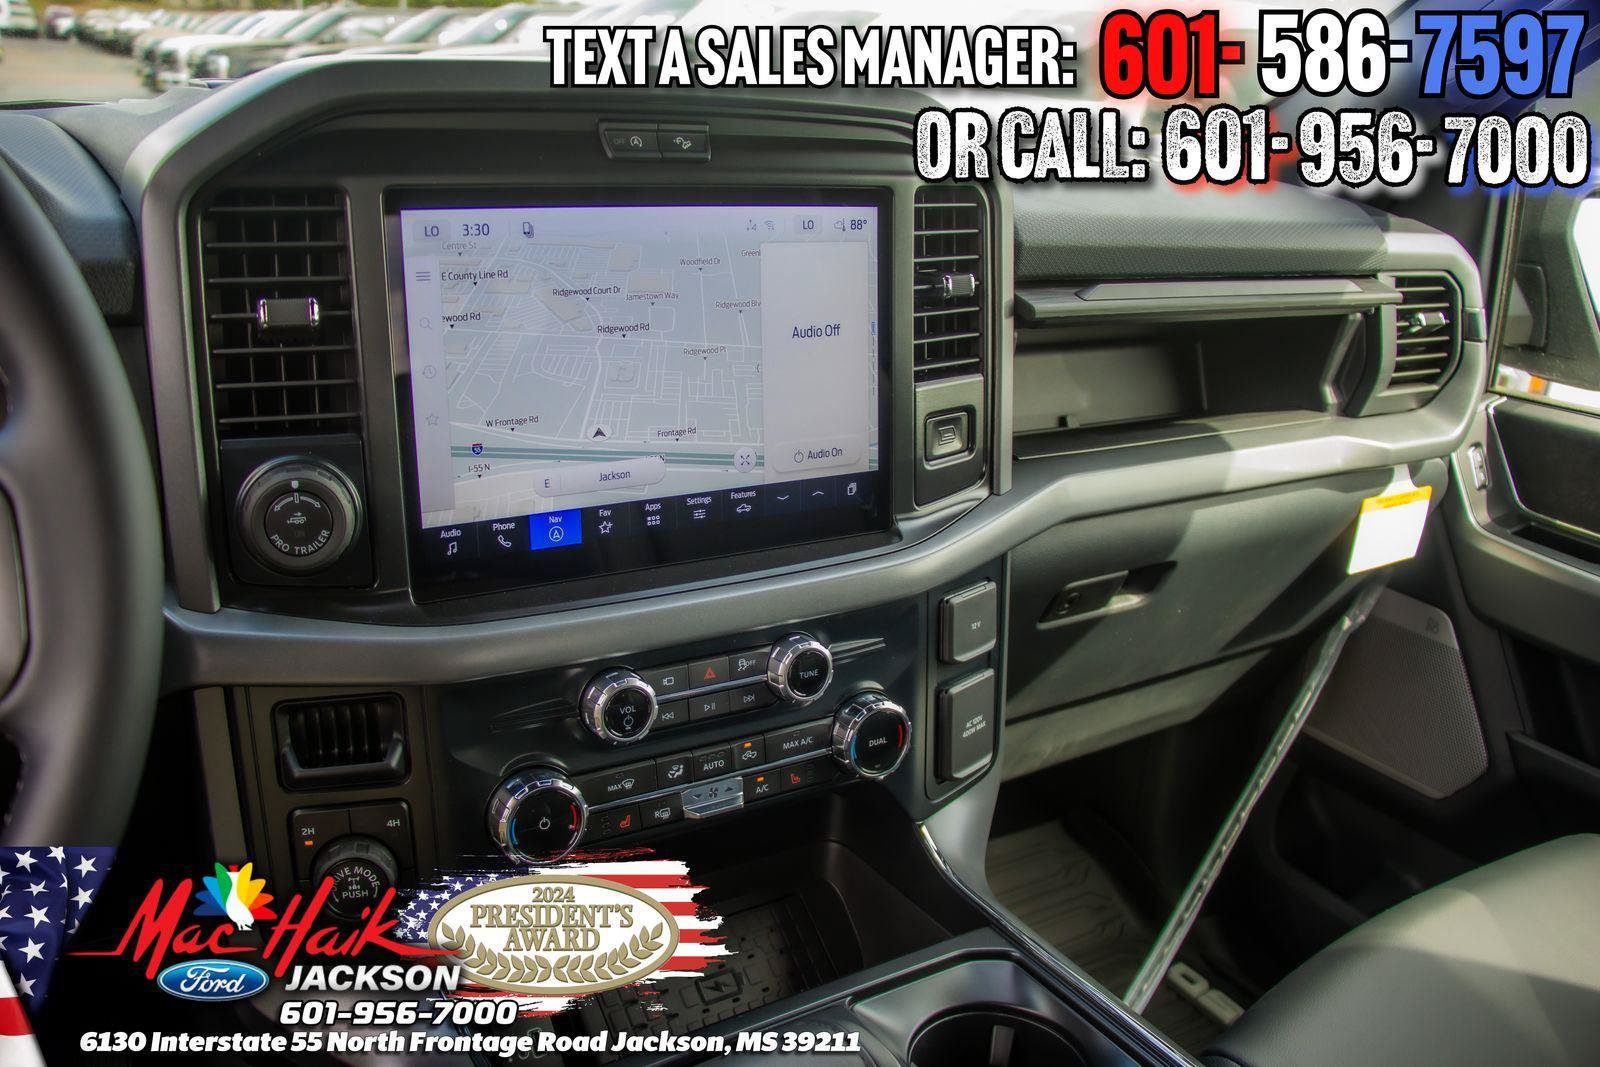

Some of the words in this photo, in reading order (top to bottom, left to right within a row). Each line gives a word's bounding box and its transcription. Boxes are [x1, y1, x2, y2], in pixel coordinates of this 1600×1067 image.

[802, 220, 814, 230] LO
[850, 219, 868, 230] 88°
[424, 225, 440, 237] LO
[462, 223, 490, 237] 3:30
[441, 241, 466, 250] Centre
[468, 241, 478, 250] St
[680, 257, 712, 266] Woodfield
[713, 257, 721, 265] Dr
[441, 272, 447, 281] E
[448, 271, 478, 283] County
[479, 271, 496, 280] Line
[497, 270, 509, 279] Rd
[552, 288, 592, 299] Ridgewood
[593, 286, 612, 296] Court
[613, 286, 621, 294] Dr
[625, 292, 664, 302] Jamestown
[664, 291, 679, 301] Way
[715, 300, 749, 310] Ridgewood
[469, 312, 481, 321] Rd
[597, 324, 638, 334] Ridgewood
[639, 323, 650, 332] Rd
[792, 325, 823, 339] Audio
[825, 324, 841, 337] Off
[683, 347, 717, 357] Ridgewood
[485, 419, 494, 428] W
[495, 417, 528, 428] Frontage
[529, 415, 539, 425] Rd
[657, 428, 687, 439] Frontage
[687, 426, 697, 435] Rd
[807, 449, 831, 461] Audio
[831, 448, 843, 458] On
[468, 464, 484, 473] I-55
[484, 463, 491, 472] N
[599, 470, 631, 482] Jackson
[544, 479, 551, 488] E
[730, 490, 756, 500] Features
[687, 495, 712, 506] Settings
[645, 502, 661, 512] Apps
[599, 509, 611, 518] Fav
[549, 515, 563, 524] Nav
[492, 522, 516, 531] Phone
[440, 529, 461, 539] Audio
[270, 534, 290, 552] PRO
[294, 529, 331, 555] TRAILER
[800, 668, 819, 679] TUNE
[619, 706, 637, 715] VOL
[783, 739, 800, 750] MAX
[800, 736, 813, 746] A/C
[868, 737, 888, 747] DUAL
[703, 759, 725, 771] AUTO
[607, 782, 622, 793] MAX
[755, 784, 769, 794] A/C
[386, 819, 401, 828] 4H
[301, 827, 315, 836] 2H
[354, 866, 381, 888] MODE
[342, 889, 369, 900] PUSH
